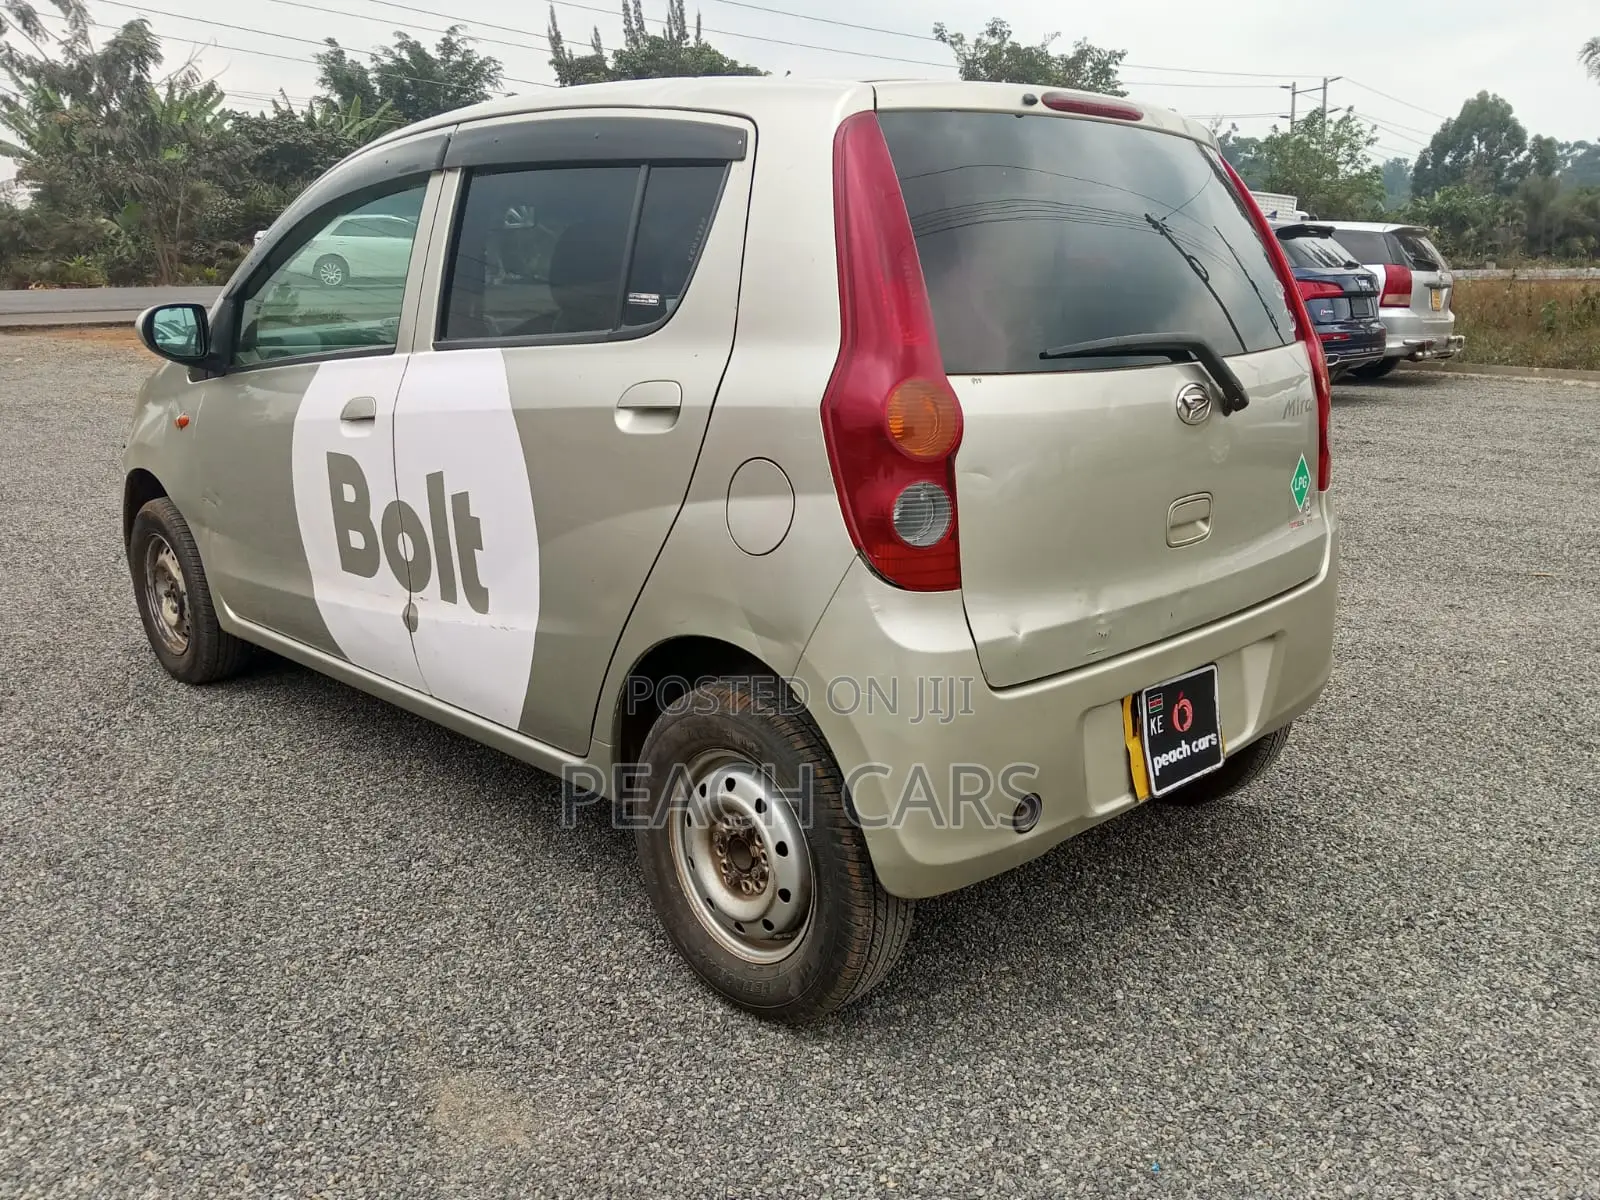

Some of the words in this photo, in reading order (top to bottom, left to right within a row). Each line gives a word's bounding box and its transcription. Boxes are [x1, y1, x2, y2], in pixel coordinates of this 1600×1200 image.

[1282, 395, 1313, 419] Mira
[1294, 475, 1308, 491] LPG
[326, 450, 490, 615] Bolt
[1150, 714, 1165, 736] KE
[1153, 740, 1191, 776] peach
[1191, 732, 1218, 753] cars
